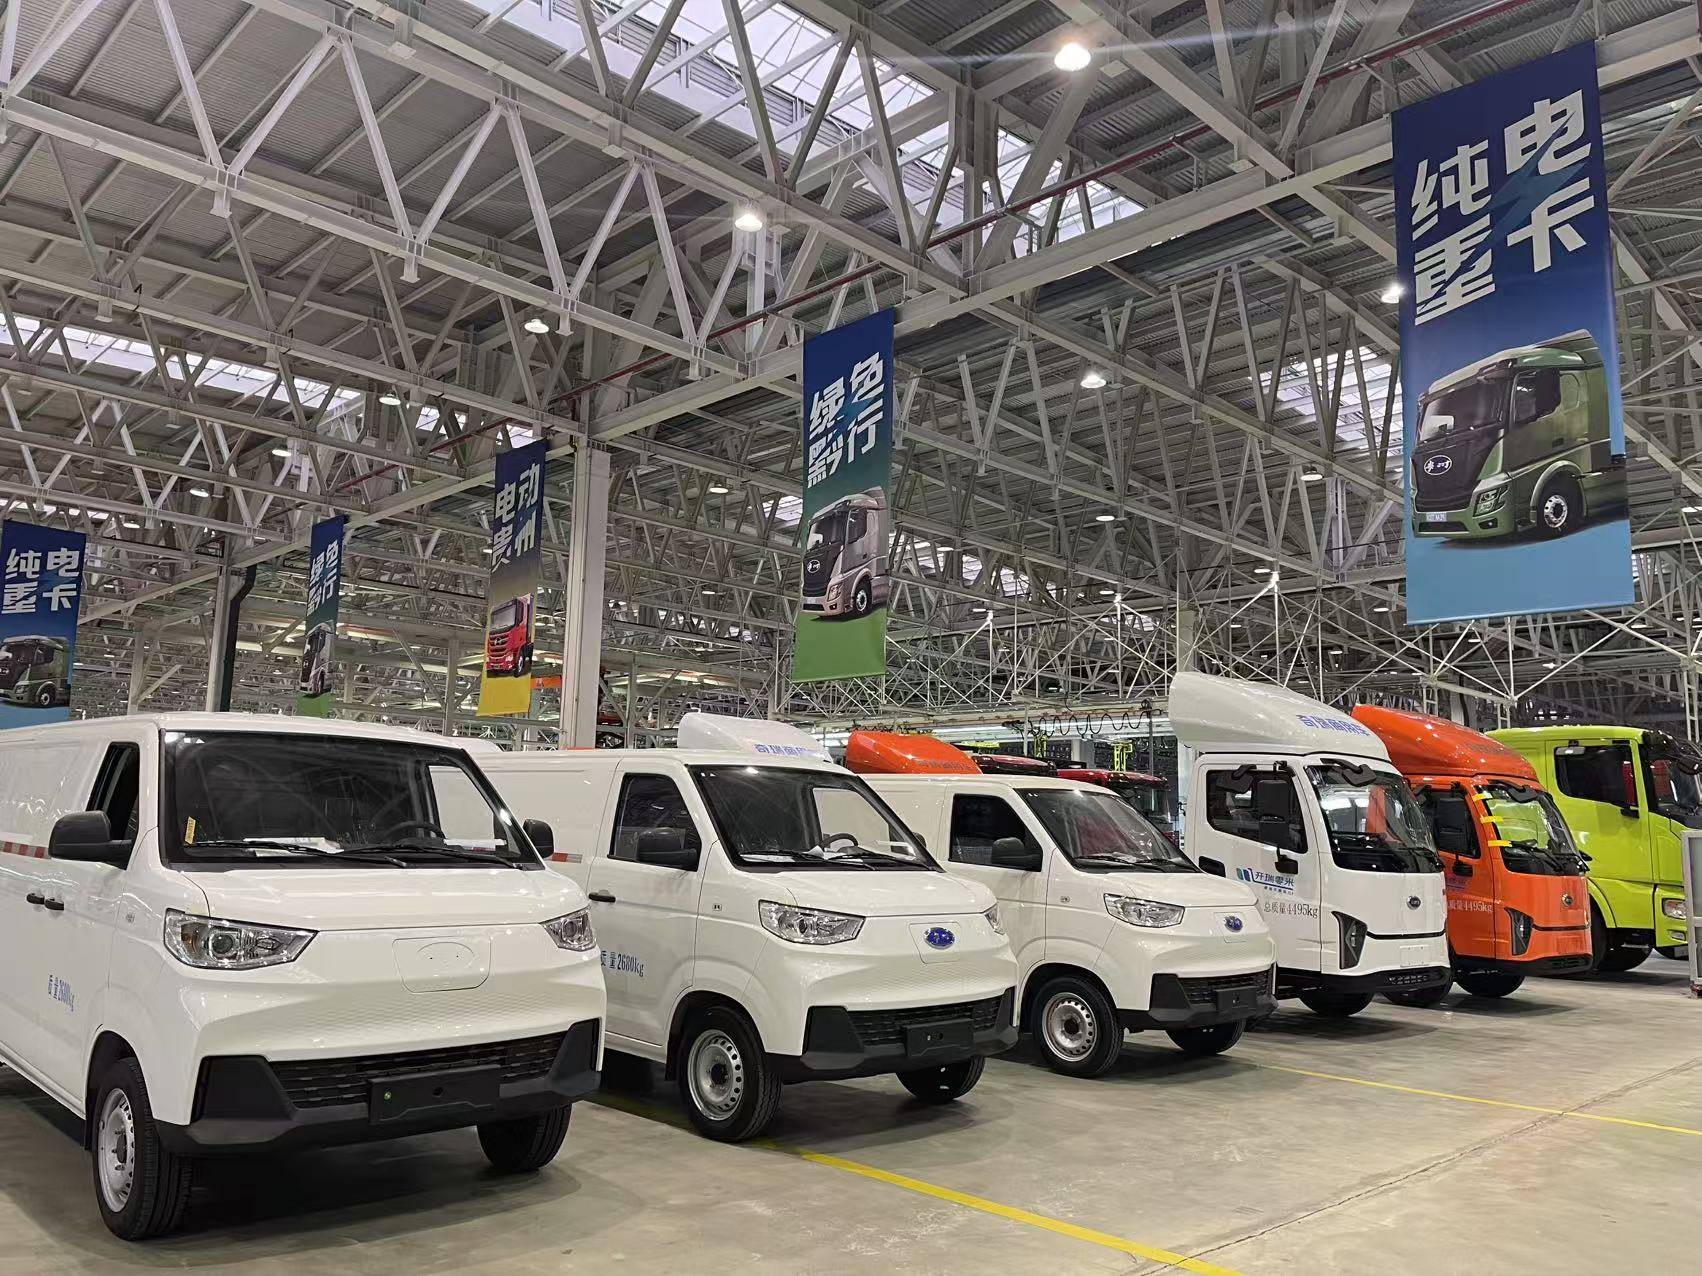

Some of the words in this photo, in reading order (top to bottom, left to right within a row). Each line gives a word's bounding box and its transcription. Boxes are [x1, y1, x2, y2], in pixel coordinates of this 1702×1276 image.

[1412, 89, 1592, 240] 纯电
[1414, 176, 1595, 326] 重卡
[809, 351, 885, 440] 绿色
[495, 463, 541, 524] 电动
[5, 548, 80, 579] 纯电
[491, 510, 537, 573] 贵州
[2, 581, 77, 614] 重卡
